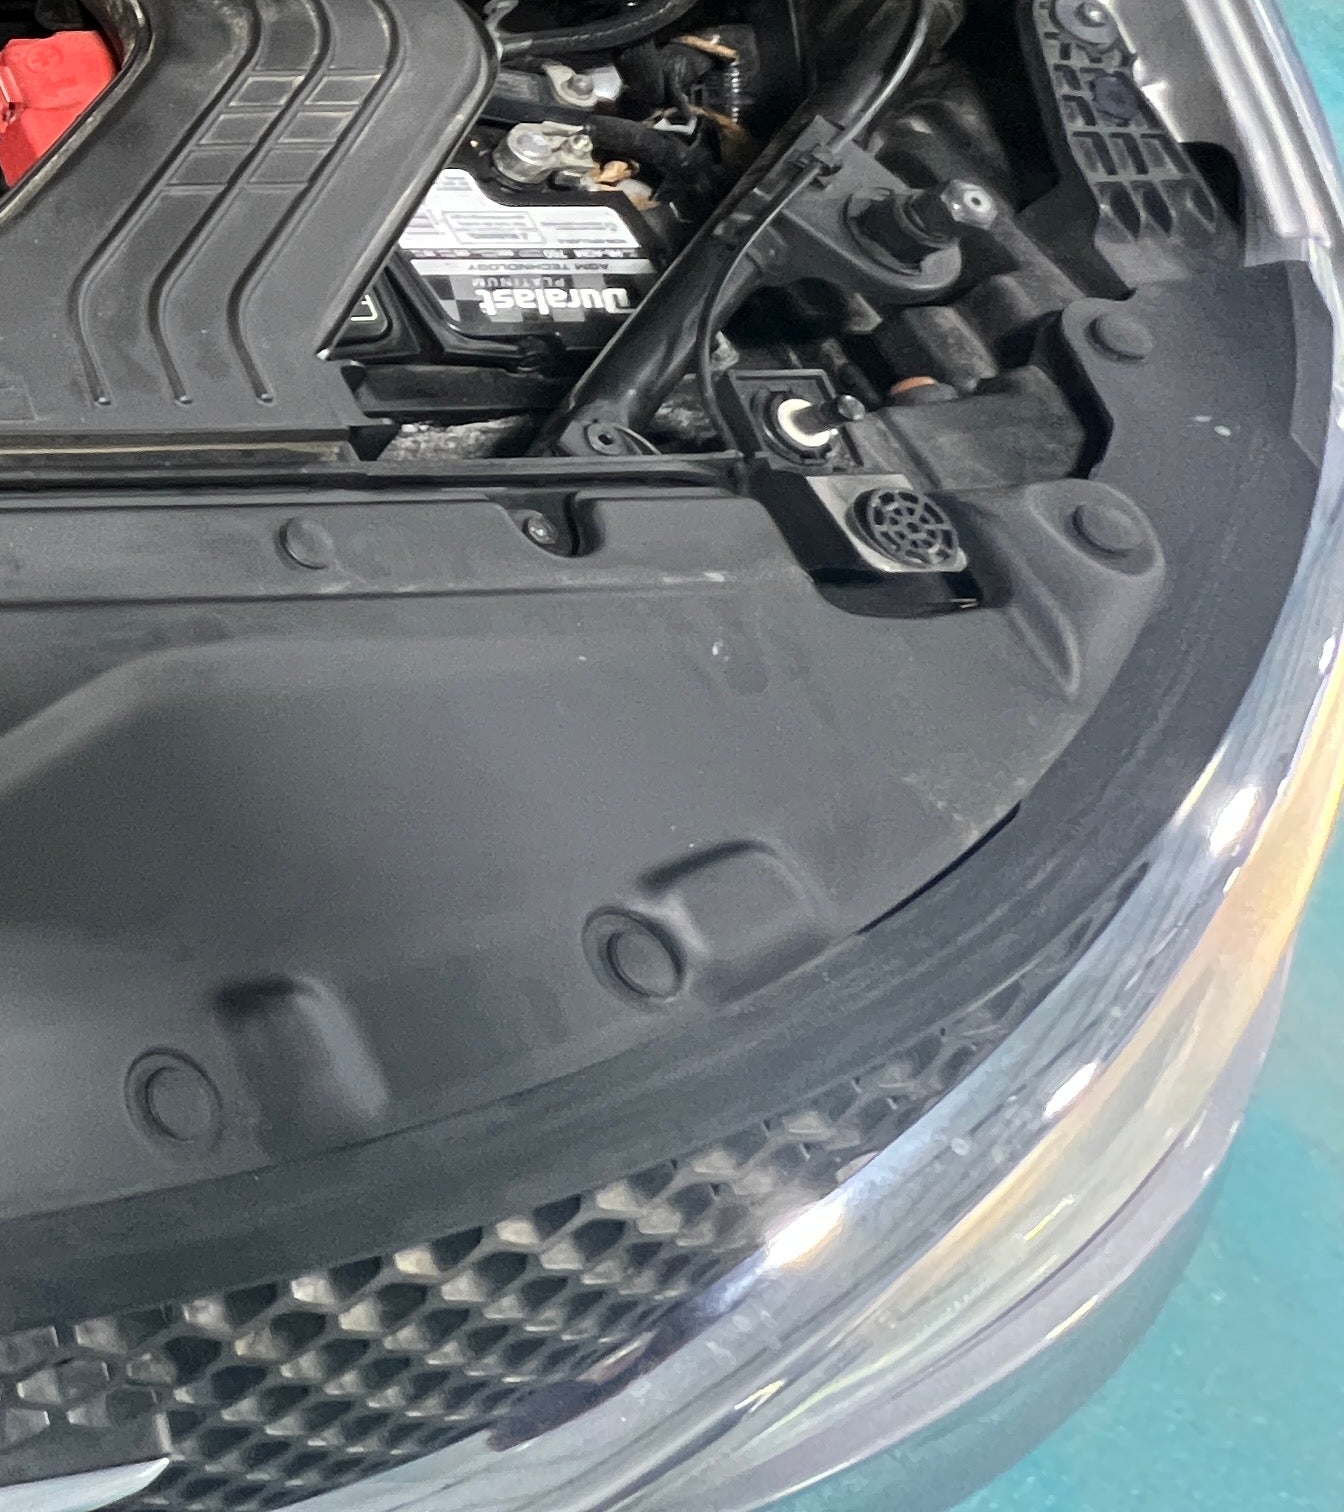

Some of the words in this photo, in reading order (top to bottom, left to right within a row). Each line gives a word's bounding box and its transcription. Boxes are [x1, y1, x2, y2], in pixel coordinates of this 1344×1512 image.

[468, 262, 571, 271] TECHNOLOGY
[575, 262, 609, 271] AGM
[471, 277, 565, 288] PLATINUM
[475, 288, 637, 316] Duralast
